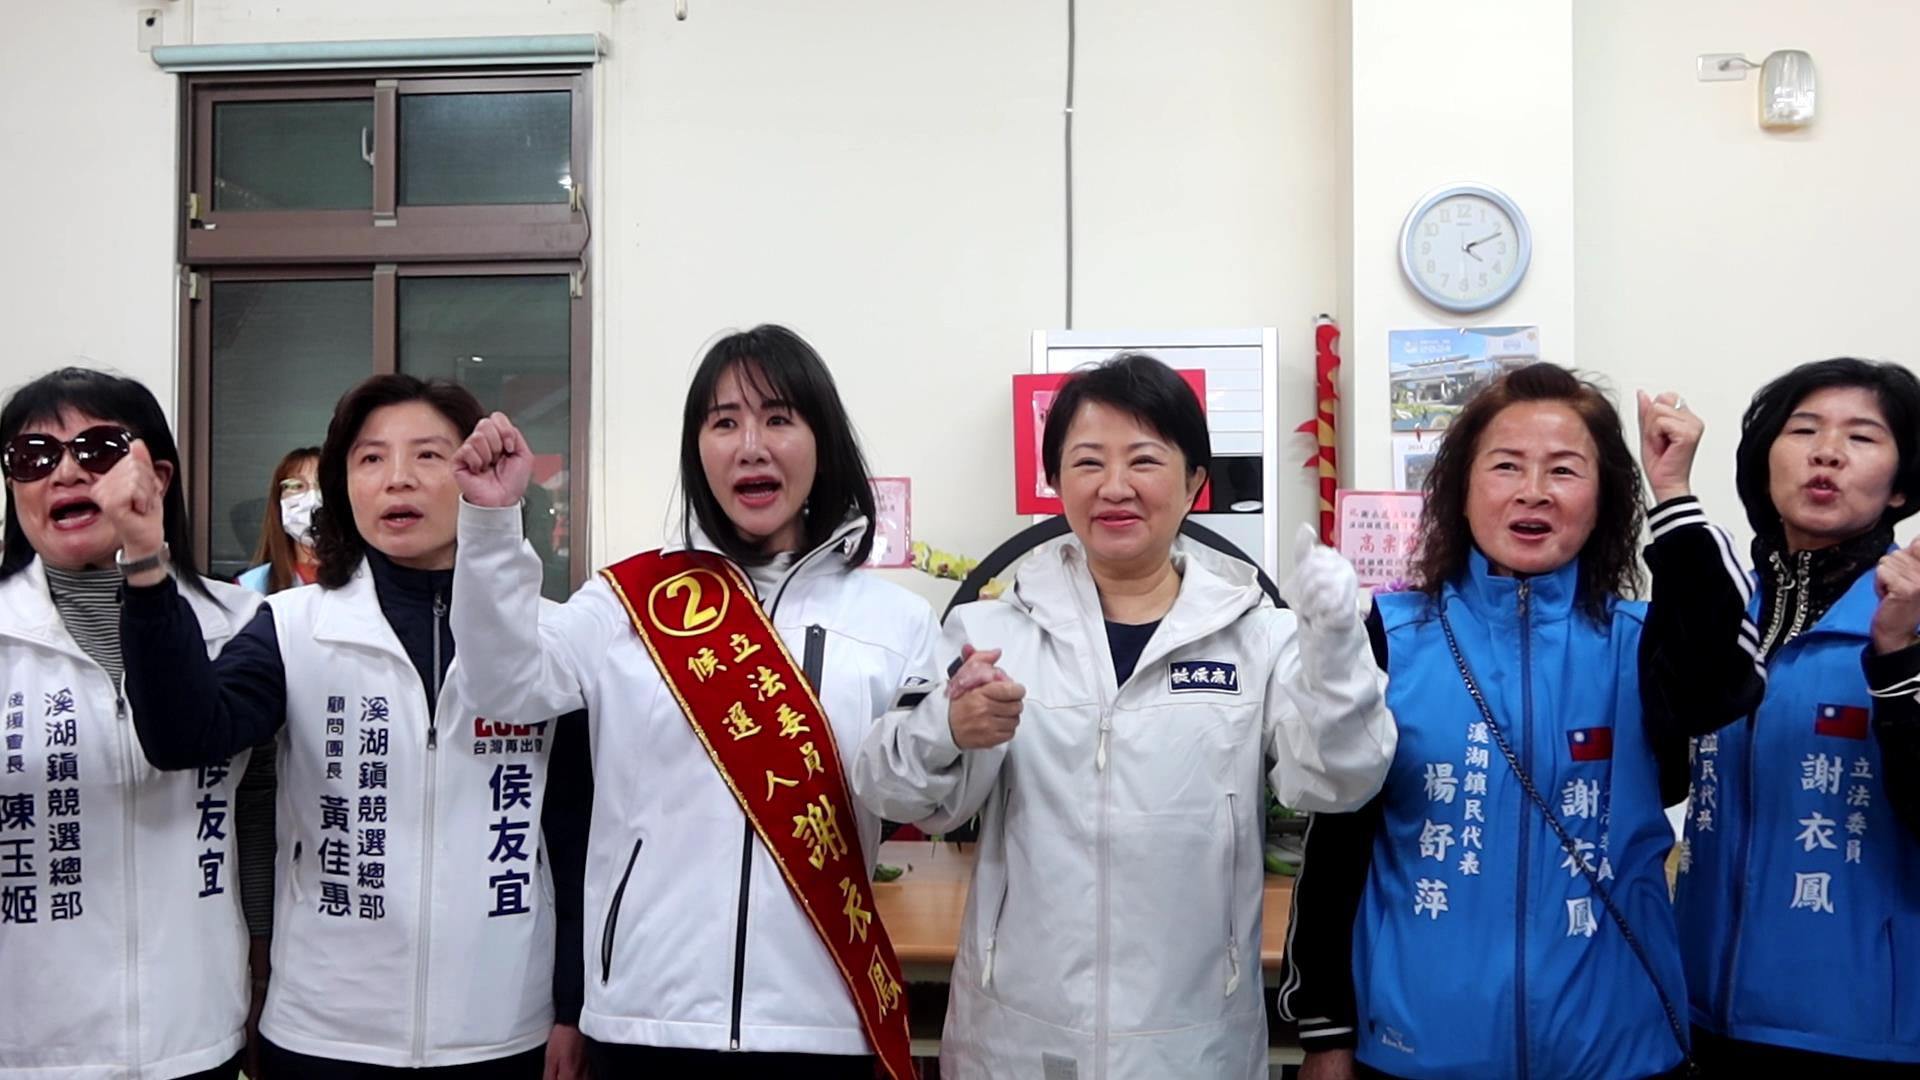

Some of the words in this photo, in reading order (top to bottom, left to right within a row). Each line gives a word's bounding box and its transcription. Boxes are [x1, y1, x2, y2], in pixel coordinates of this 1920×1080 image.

[1422, 242, 1431, 255] 9
[1424, 223, 1439, 237] 10
[1440, 209, 1451, 223] 11
[1456, 204, 1472, 218] 12
[1498, 242, 1506, 255] 3
[1427, 261, 1436, 274] 8
[1440, 273, 1449, 288] 7
[1479, 273, 1488, 287] 5
[1492, 261, 1502, 274] 4
[666, 576, 718, 630] 2
[325, 695, 346, 780] 顧問團長
[687, 646, 800, 802] 候選人
[728, 632, 825, 780] 立法委員
[44, 687, 83, 921] 溪湖鎮競選總部
[356, 695, 389, 921] 溪湖鎮競選總部
[487, 763, 533, 918] 侯友宜
[1413, 762, 1459, 920] 楊舒萍
[1458, 721, 1489, 876] 溪湖鎮民代表
[1790, 752, 1844, 914] 謝衣鳳
[1844, 756, 1873, 864] 立法委員
[317, 794, 351, 919] 黃佳惠
[791, 794, 903, 1024] 謝衣鳳
